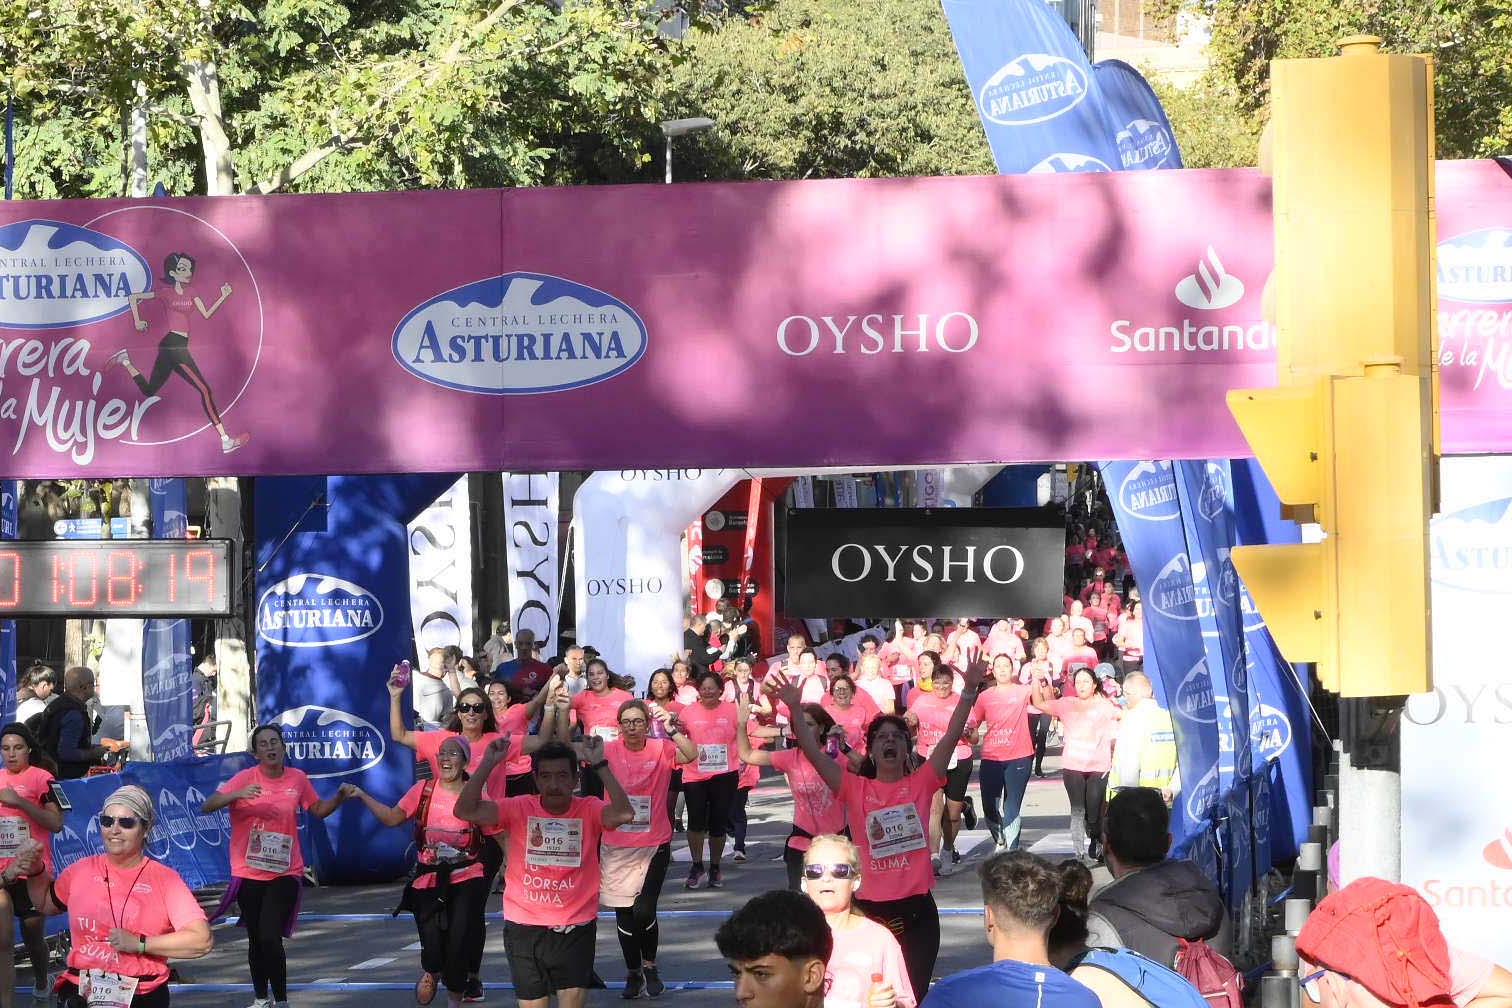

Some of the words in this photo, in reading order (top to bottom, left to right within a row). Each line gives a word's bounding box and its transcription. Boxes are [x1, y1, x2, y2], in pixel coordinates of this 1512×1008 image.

[55, 256, 127, 267] LECHERA
[451, 315, 530, 327] CENTRAL
[538, 313, 619, 326] LECHERA
[412, 319, 627, 364] ASTURIANA
[776, 312, 979, 356] OYSHO
[1110, 320, 1279, 353] Santand
[12, 372, 162, 466] Mujer
[832, 542, 1025, 585] OYSHO
[587, 578, 663, 597] OYSHO
[274, 598, 316, 608] CENTRAL
[321, 598, 369, 607] LECHERA
[262, 598, 374, 630] ASTURIANA
[544, 837, 563, 845] 016
[870, 856, 909, 871] SUMA
[523, 874, 575, 890] DORSAL
[523, 890, 563, 904] SUMA
[79, 943, 120, 964] SUMA
